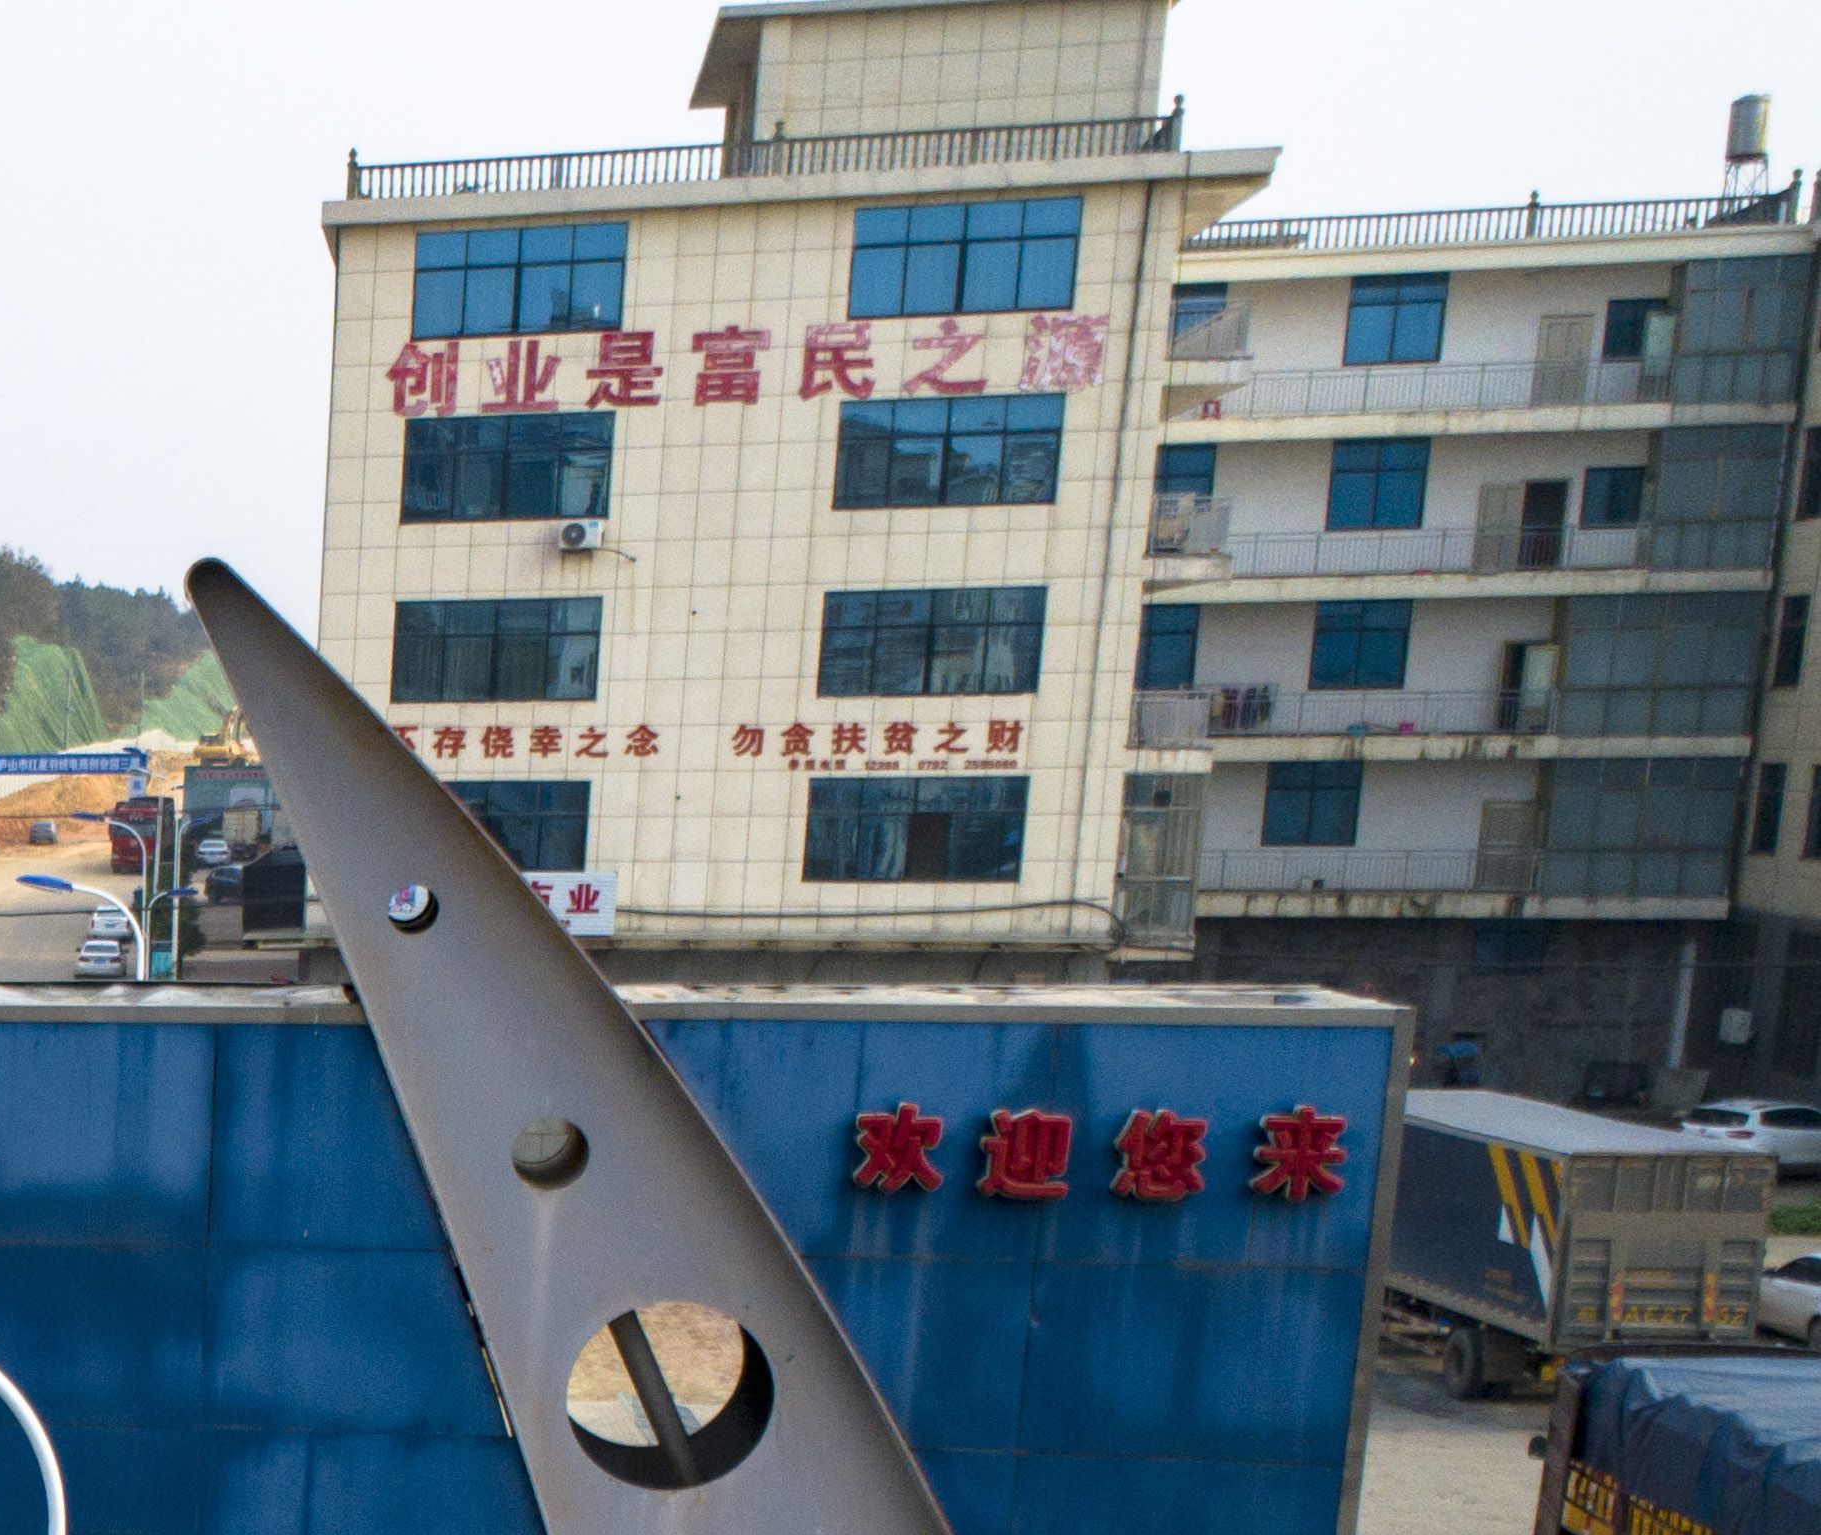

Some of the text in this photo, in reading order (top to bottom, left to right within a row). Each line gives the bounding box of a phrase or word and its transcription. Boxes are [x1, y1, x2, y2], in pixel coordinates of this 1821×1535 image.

[386, 314, 1109, 417] 创业是富民之源
[732, 720, 1024, 757] 勿贪扶贫之财
[854, 1102, 1347, 1199] 欢迎您来
